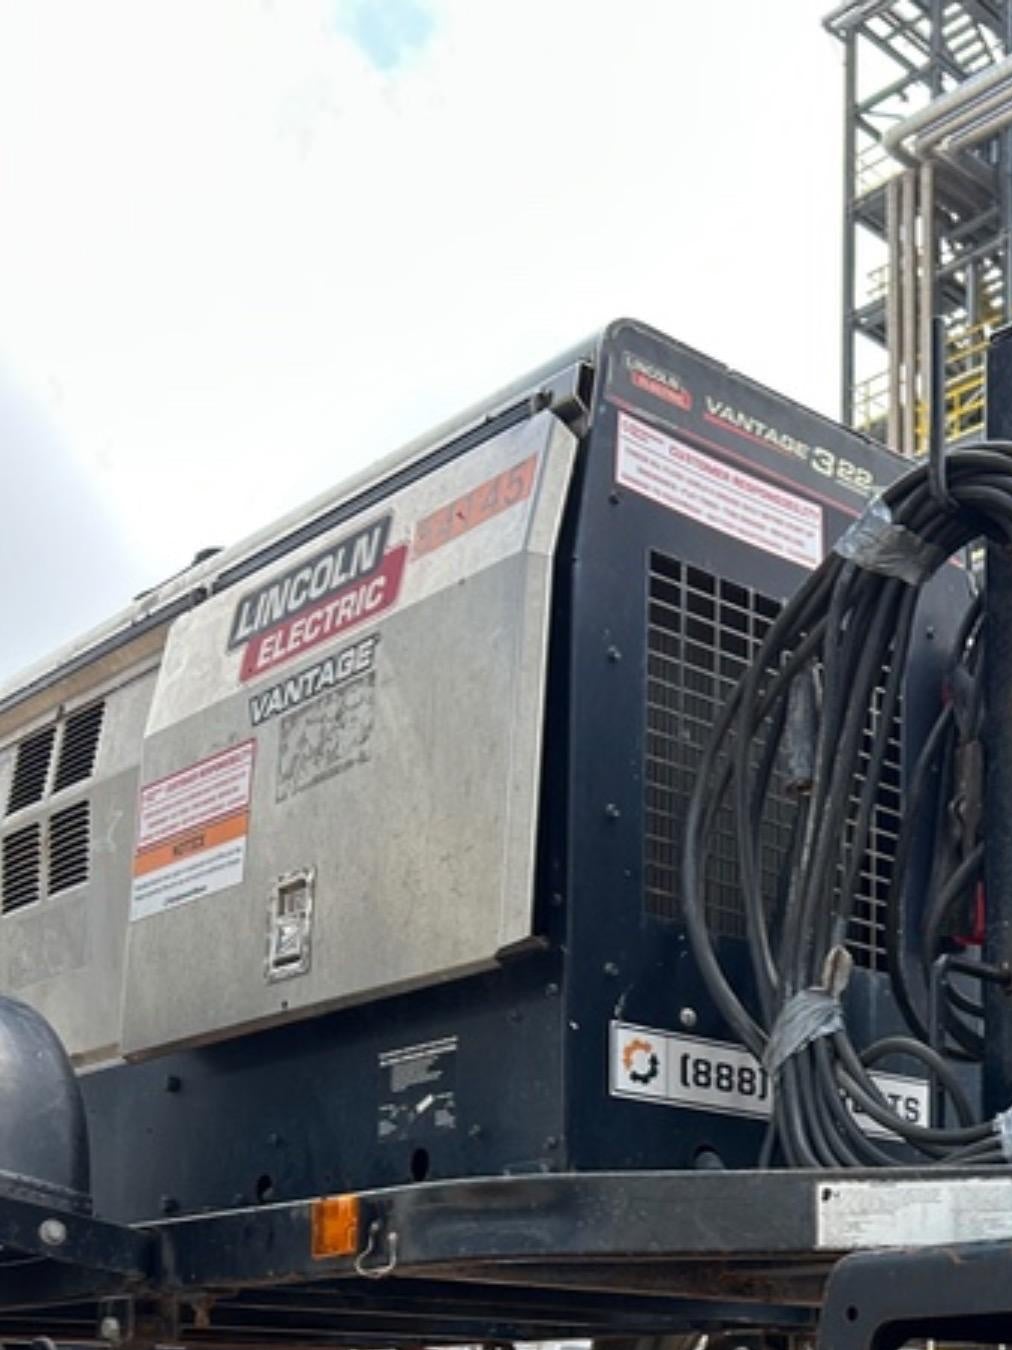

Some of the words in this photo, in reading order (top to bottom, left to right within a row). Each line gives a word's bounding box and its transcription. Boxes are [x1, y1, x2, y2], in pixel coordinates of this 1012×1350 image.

[705, 396, 810, 460] VANTAGE
[810, 446, 874, 487] 322
[235, 525, 383, 640] LINCOLN
[256, 574, 387, 669] ELECTRIC
[250, 636, 377, 724] VANTAGE
[680, 1053, 768, 1100] (888)
